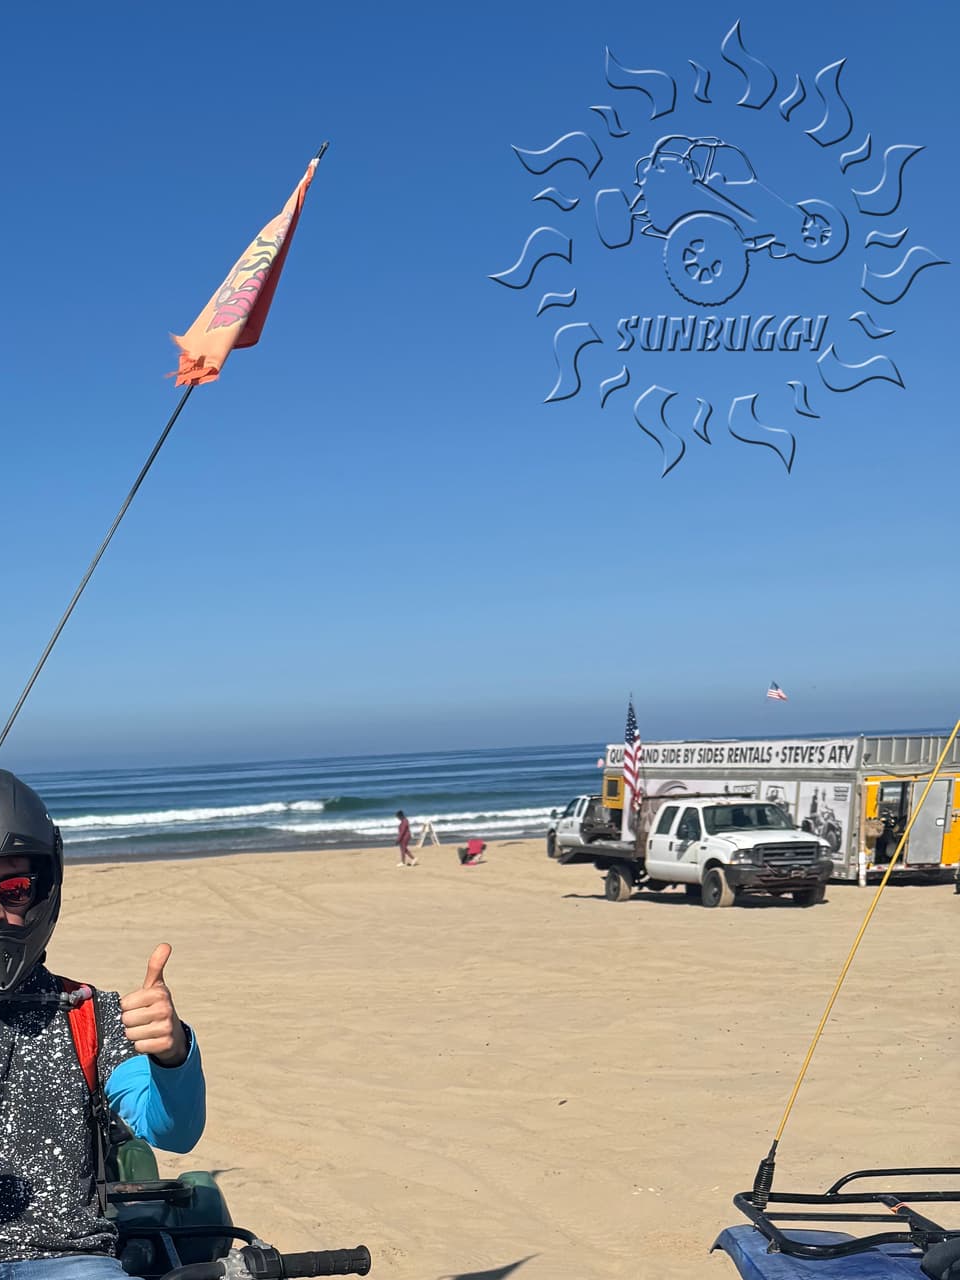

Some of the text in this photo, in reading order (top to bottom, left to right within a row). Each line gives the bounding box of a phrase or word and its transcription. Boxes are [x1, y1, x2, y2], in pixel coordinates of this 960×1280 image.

[640, 748, 660, 764] AND
[661, 748, 682, 764] SIDE
[683, 748, 696, 764] BY
[697, 747, 725, 764] SIDES
[726, 746, 773, 764] RENTALS
[780, 745, 825, 763] STEVE'S
[827, 744, 854, 763] ATV
